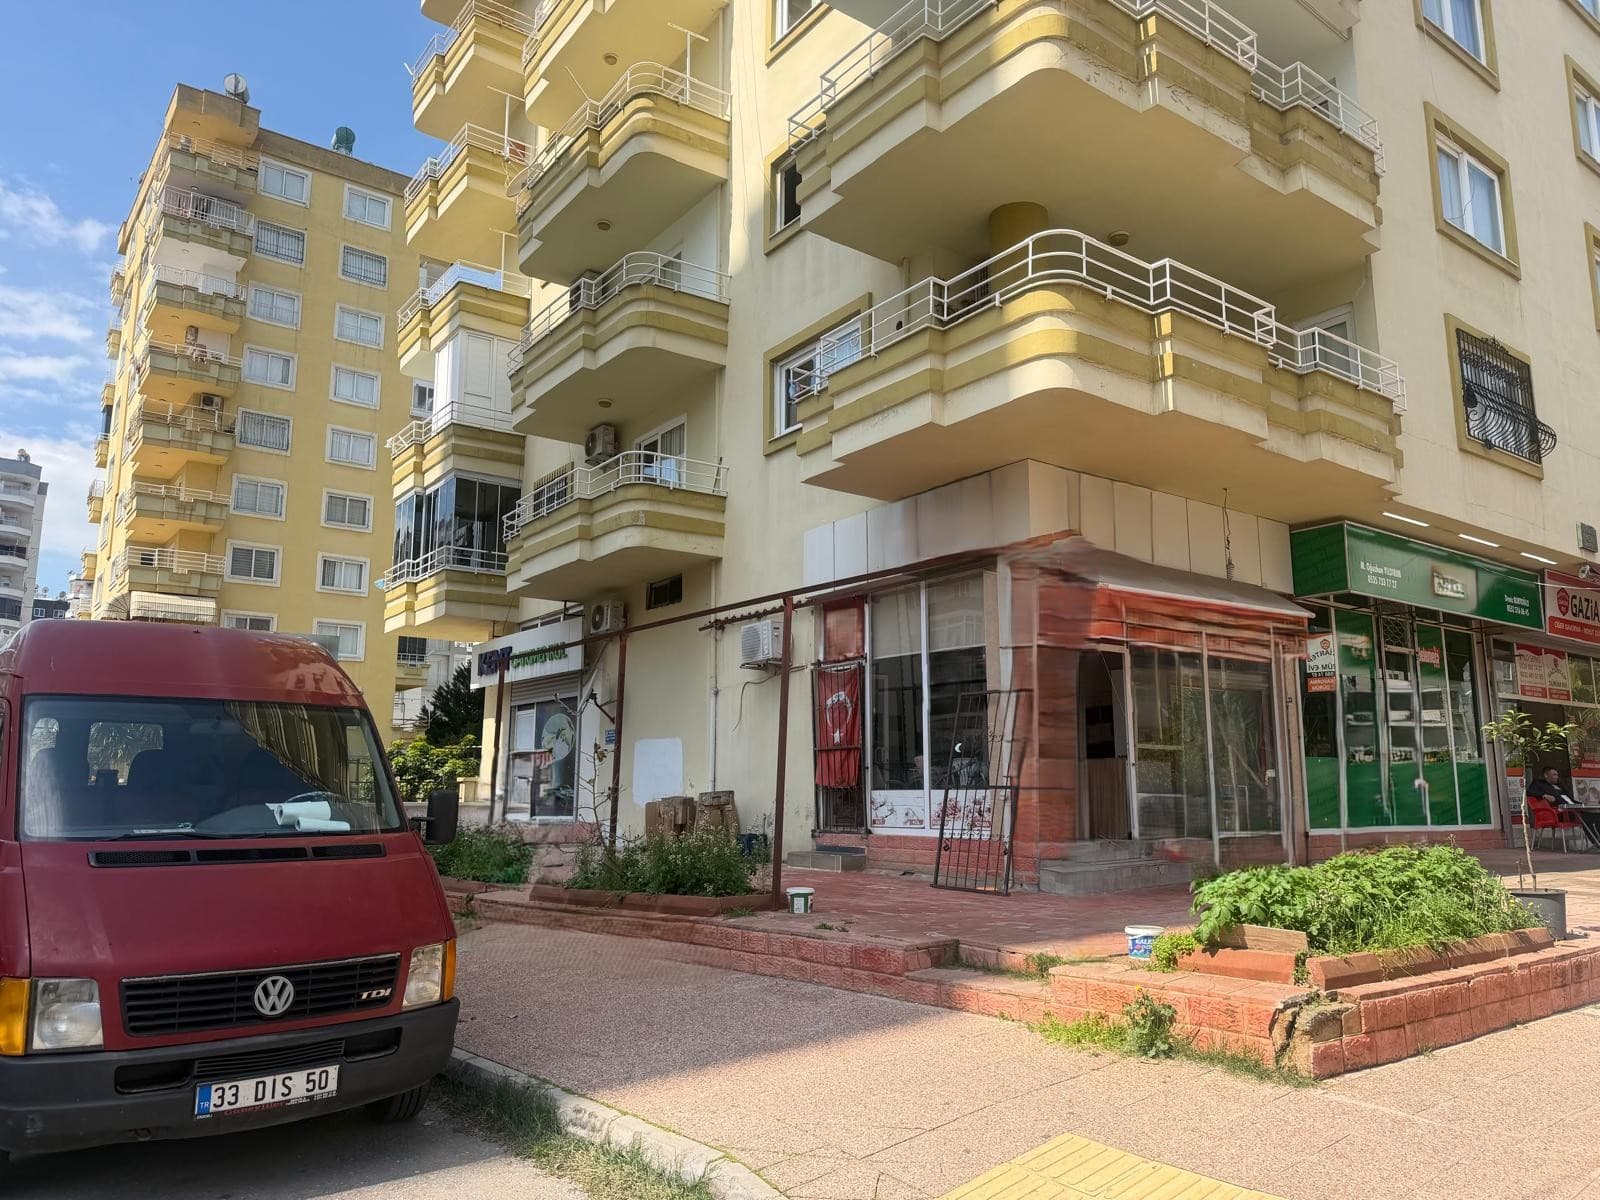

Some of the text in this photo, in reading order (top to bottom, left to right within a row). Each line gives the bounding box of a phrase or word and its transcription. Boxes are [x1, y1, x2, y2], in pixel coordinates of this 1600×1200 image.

[359, 987, 393, 1000] TDI
[199, 1101, 210, 1109] TR
[213, 1084, 240, 1109] 33
[254, 1075, 294, 1103] DIS
[305, 1069, 329, 1093] 50
